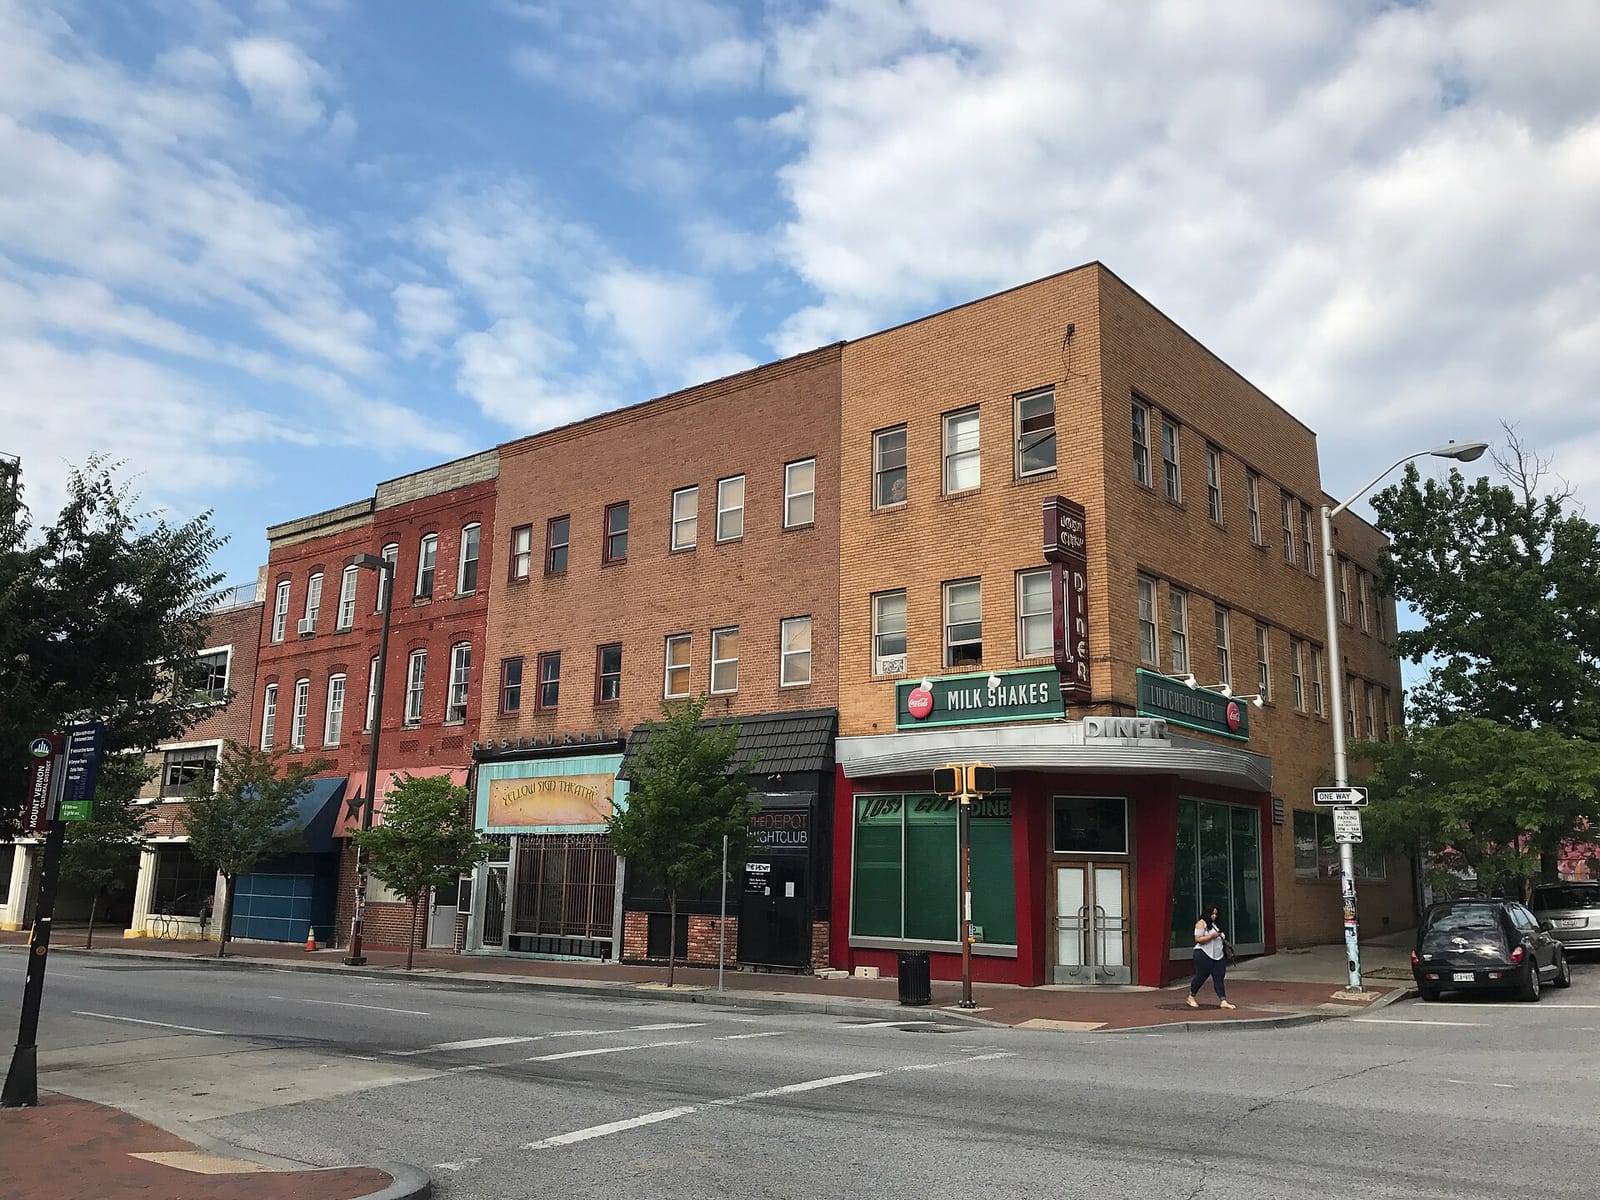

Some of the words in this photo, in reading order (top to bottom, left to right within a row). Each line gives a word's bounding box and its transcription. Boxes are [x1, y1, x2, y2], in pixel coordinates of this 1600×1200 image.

[948, 688, 982, 710] MILK
[987, 682, 1048, 707] SHAKES
[1150, 685, 1216, 721] LUNCHEONETTE
[472, 727, 623, 750] RESTAURANT
[1085, 719, 1168, 739] DINER
[34, 765, 45, 797] VERNON
[502, 783, 537, 806] YELLOW
[29, 799, 40, 828] MOUNT
[765, 814, 808, 829] DEPOT
